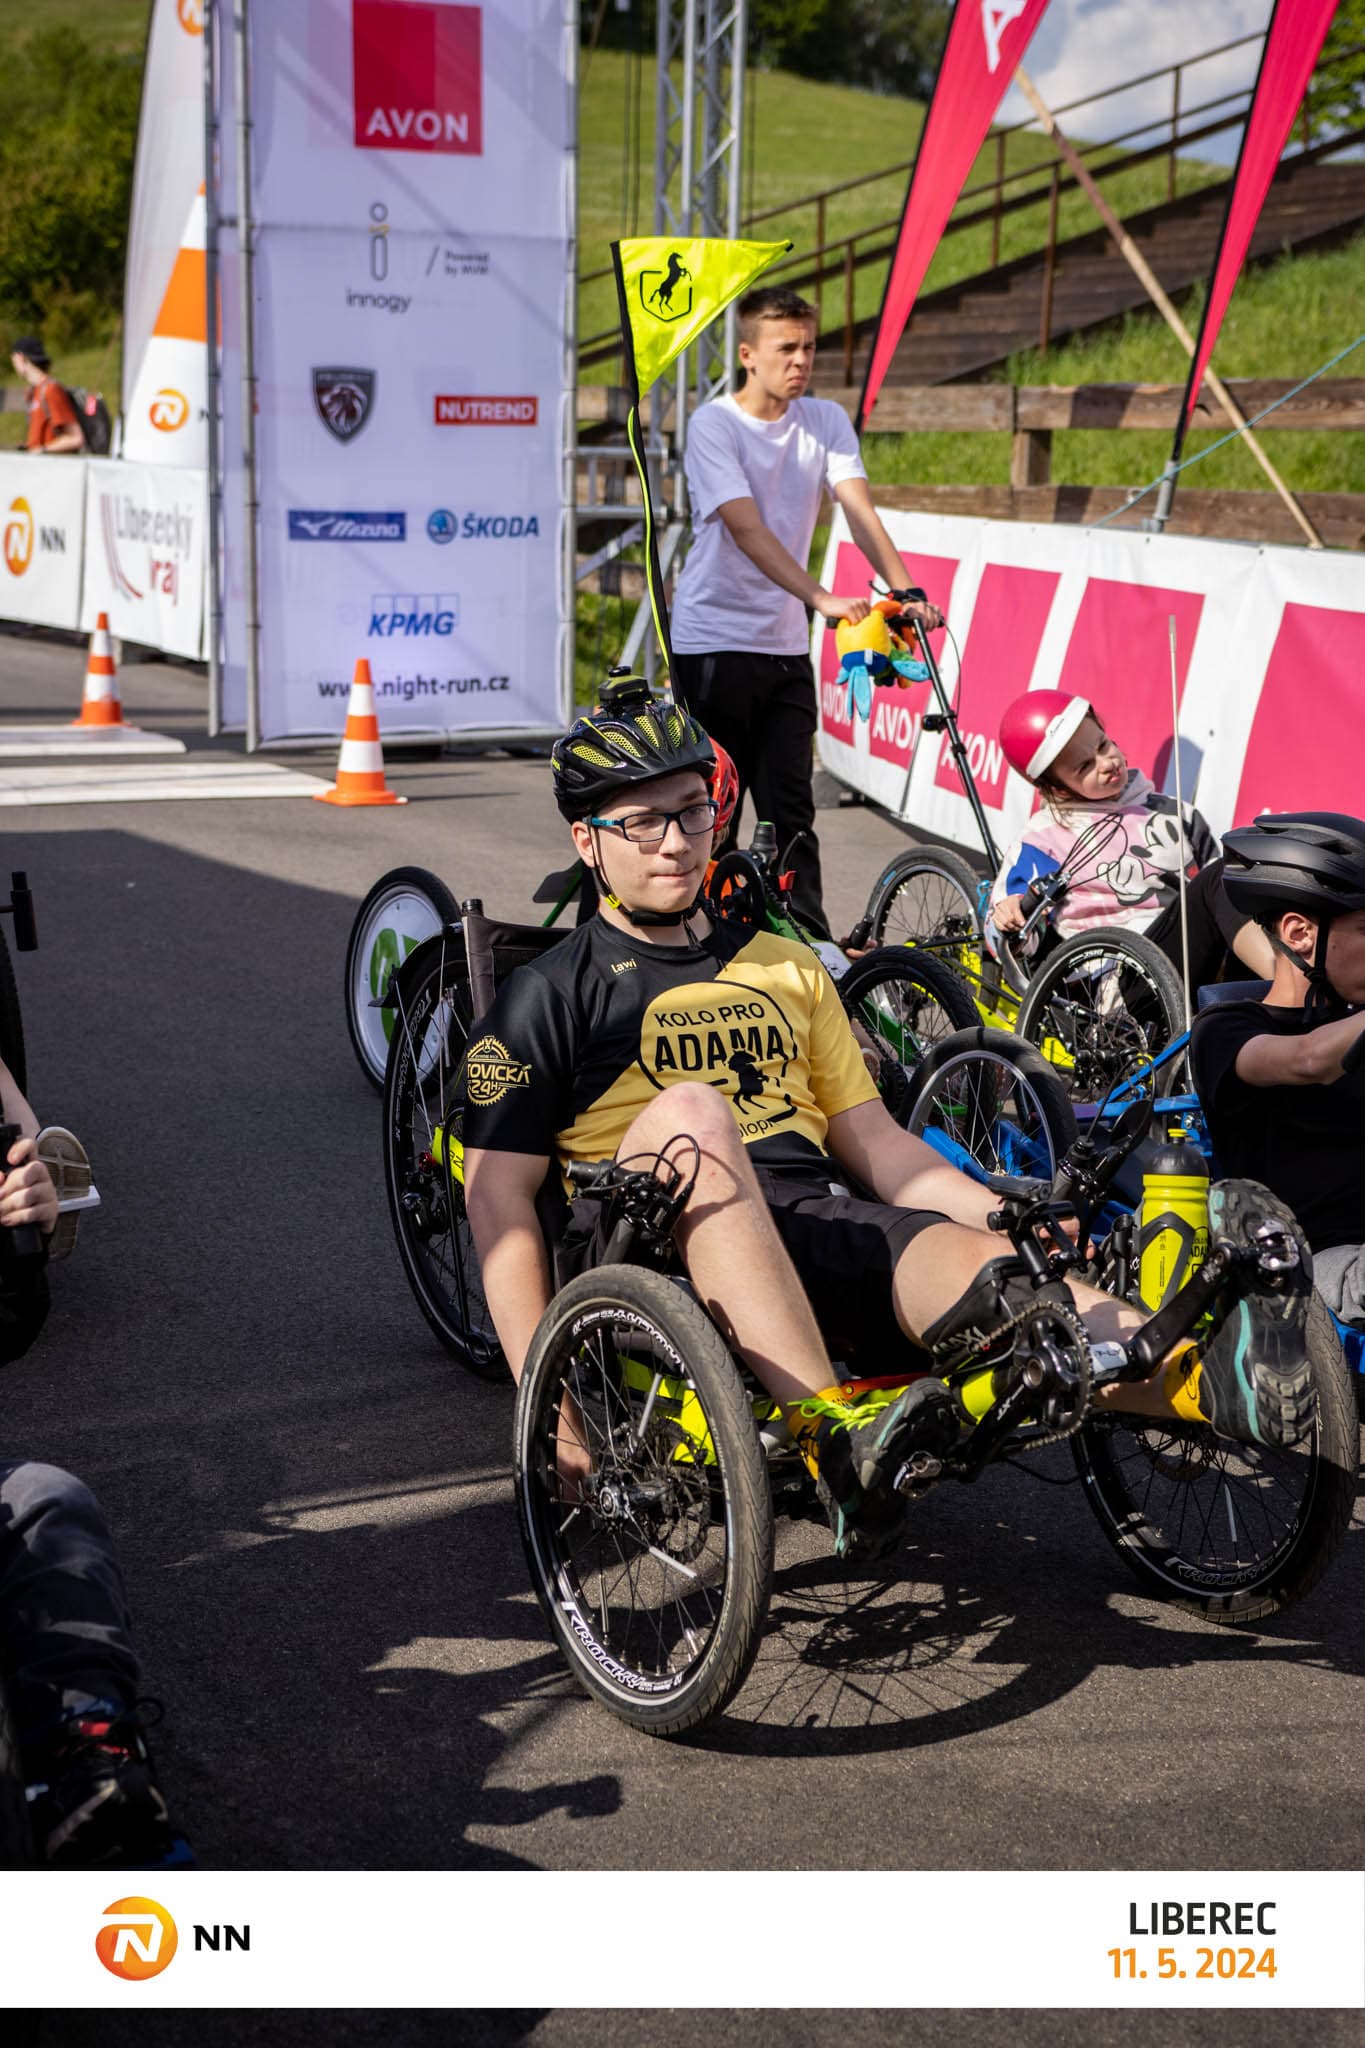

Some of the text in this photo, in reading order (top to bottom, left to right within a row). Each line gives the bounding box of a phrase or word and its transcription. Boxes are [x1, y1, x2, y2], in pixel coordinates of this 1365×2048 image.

[366, 107, 469, 143] AVON
[346, 287, 412, 314] innogy
[439, 401, 534, 420] NUTREND
[462, 512, 540, 539] ŠKODA
[39, 526, 66, 554] NN
[368, 611, 456, 637] KPMG
[318, 676, 511, 701] ww.night-run.cz
[654, 1002, 766, 1028] KOLO PRO
[655, 1025, 790, 1073] ADAMA
